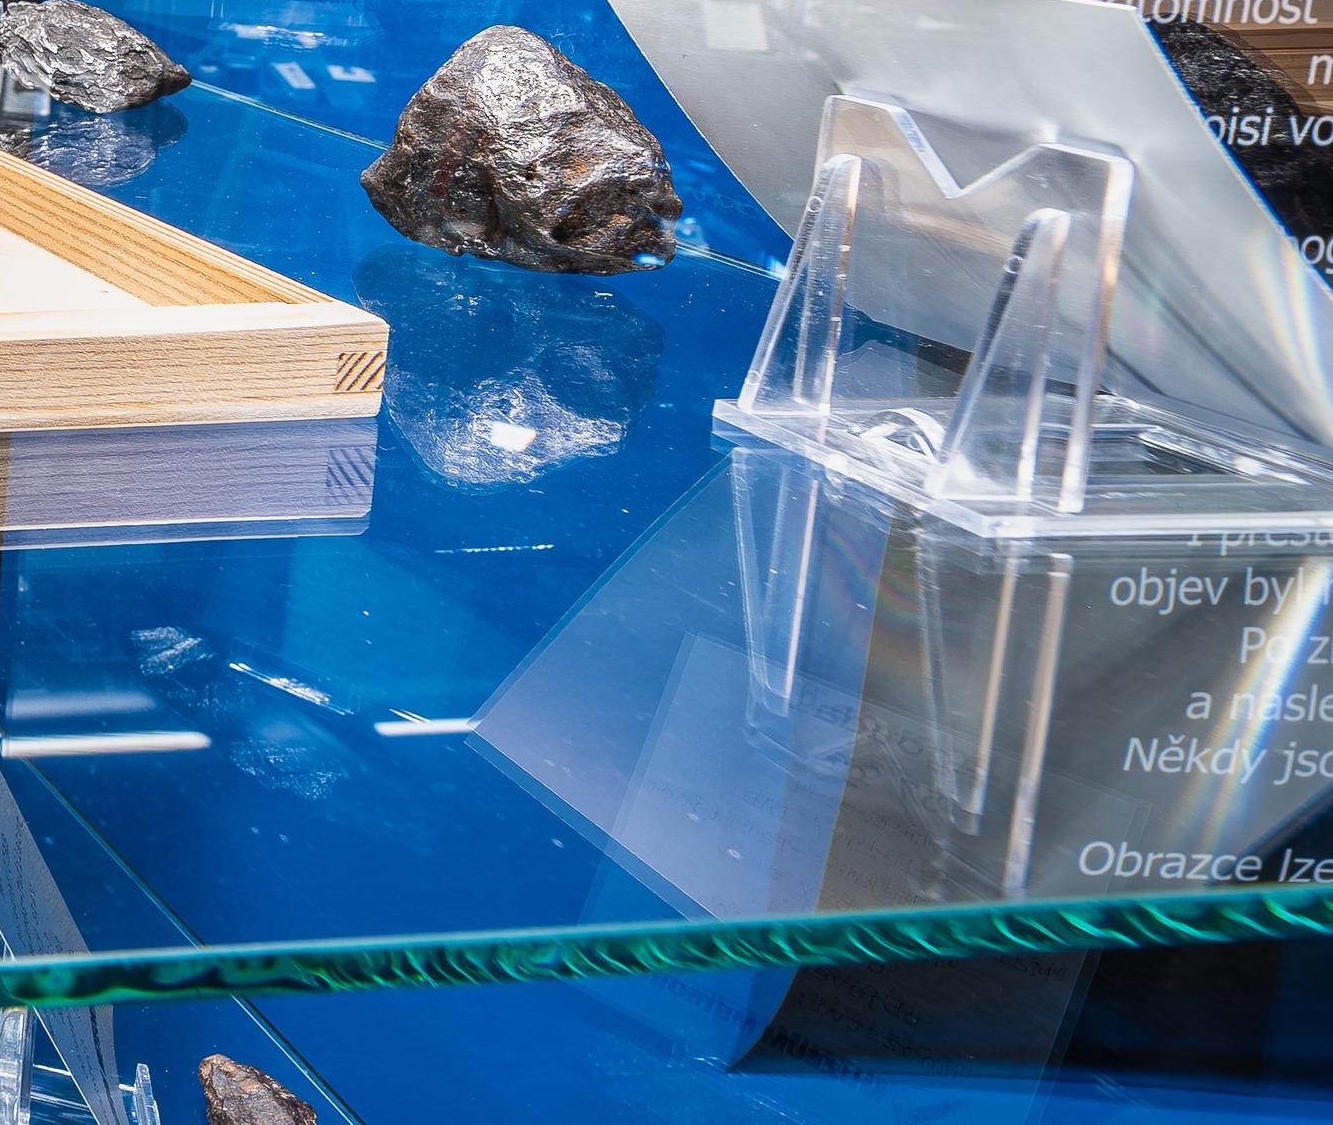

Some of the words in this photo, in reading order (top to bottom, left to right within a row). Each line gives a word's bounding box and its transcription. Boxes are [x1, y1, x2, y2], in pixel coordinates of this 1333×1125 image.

[1110, 569, 1228, 614] objev
[1185, 691, 1212, 722] a
[1123, 735, 1267, 784] Někdy
[1078, 840, 1263, 881] Obrazce
